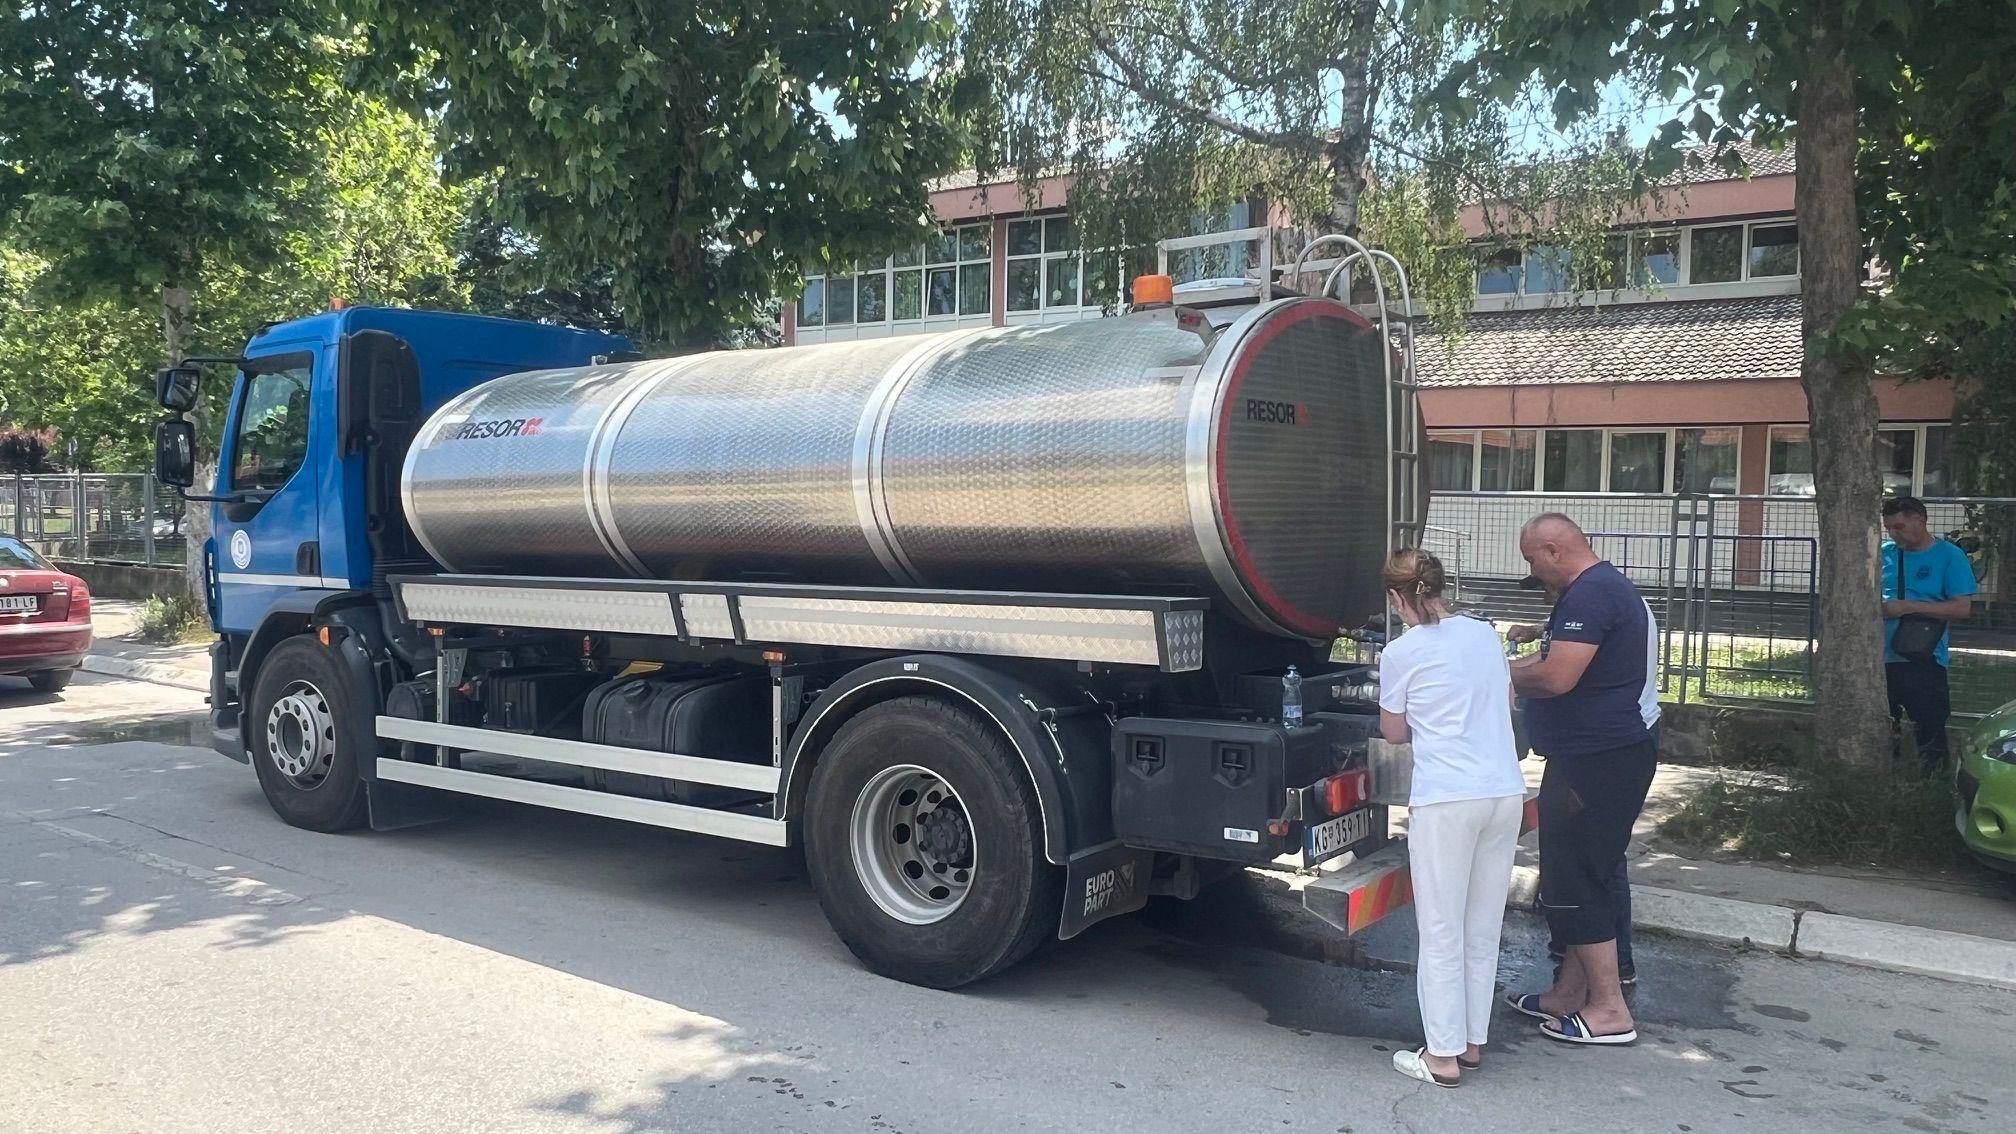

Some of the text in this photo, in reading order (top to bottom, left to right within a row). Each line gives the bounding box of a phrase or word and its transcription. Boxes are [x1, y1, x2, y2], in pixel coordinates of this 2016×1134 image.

[1246, 399, 1296, 424] RESOR
[456, 419, 526, 439] RESOR
[1314, 825, 1328, 853] KG
[1086, 869, 1115, 897] EURO
[1083, 887, 1113, 917] PART
